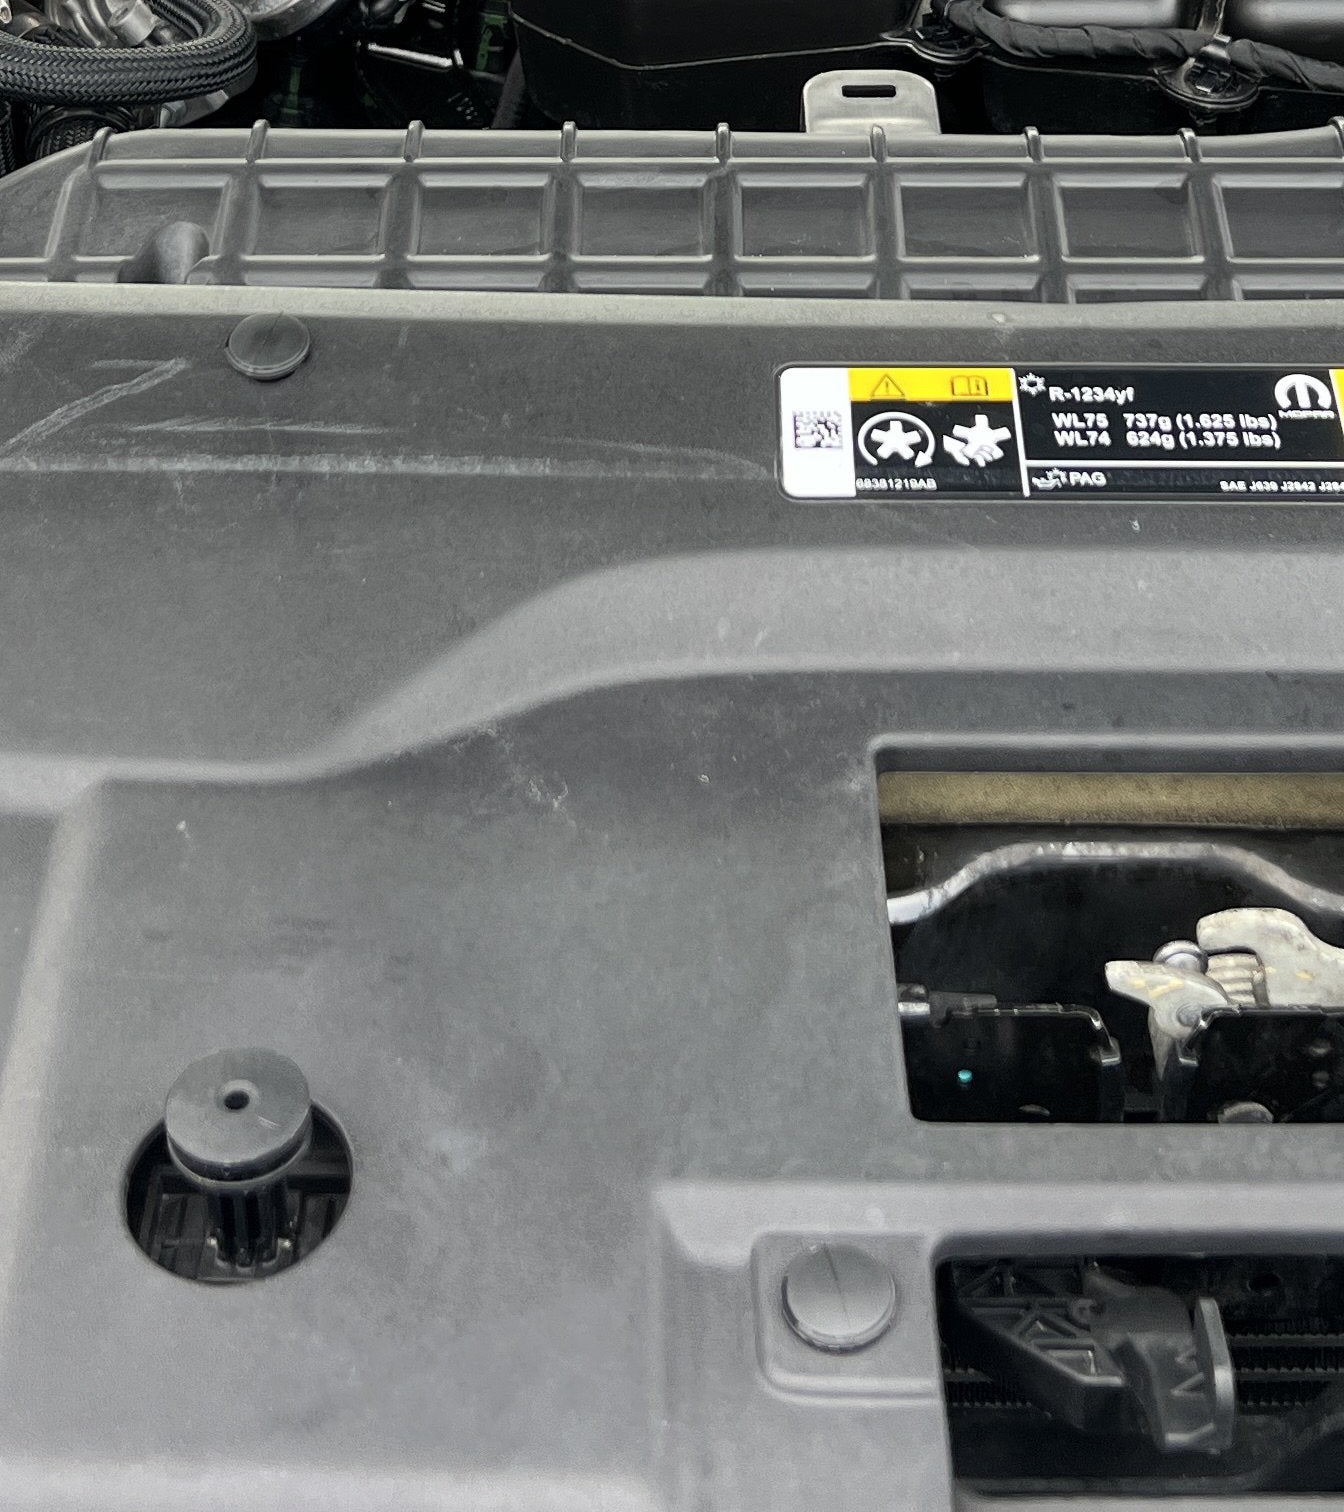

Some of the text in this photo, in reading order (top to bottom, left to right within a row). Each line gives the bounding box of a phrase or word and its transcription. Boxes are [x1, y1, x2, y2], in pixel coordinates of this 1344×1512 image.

[1048, 386, 1135, 405] R-1234yf
[1051, 412, 1277, 431] WL75 737g (1.625 lbs)
[1054, 430, 1281, 450] WL74 624g (1.375 lbs)
[1069, 471, 1107, 486] PAG
